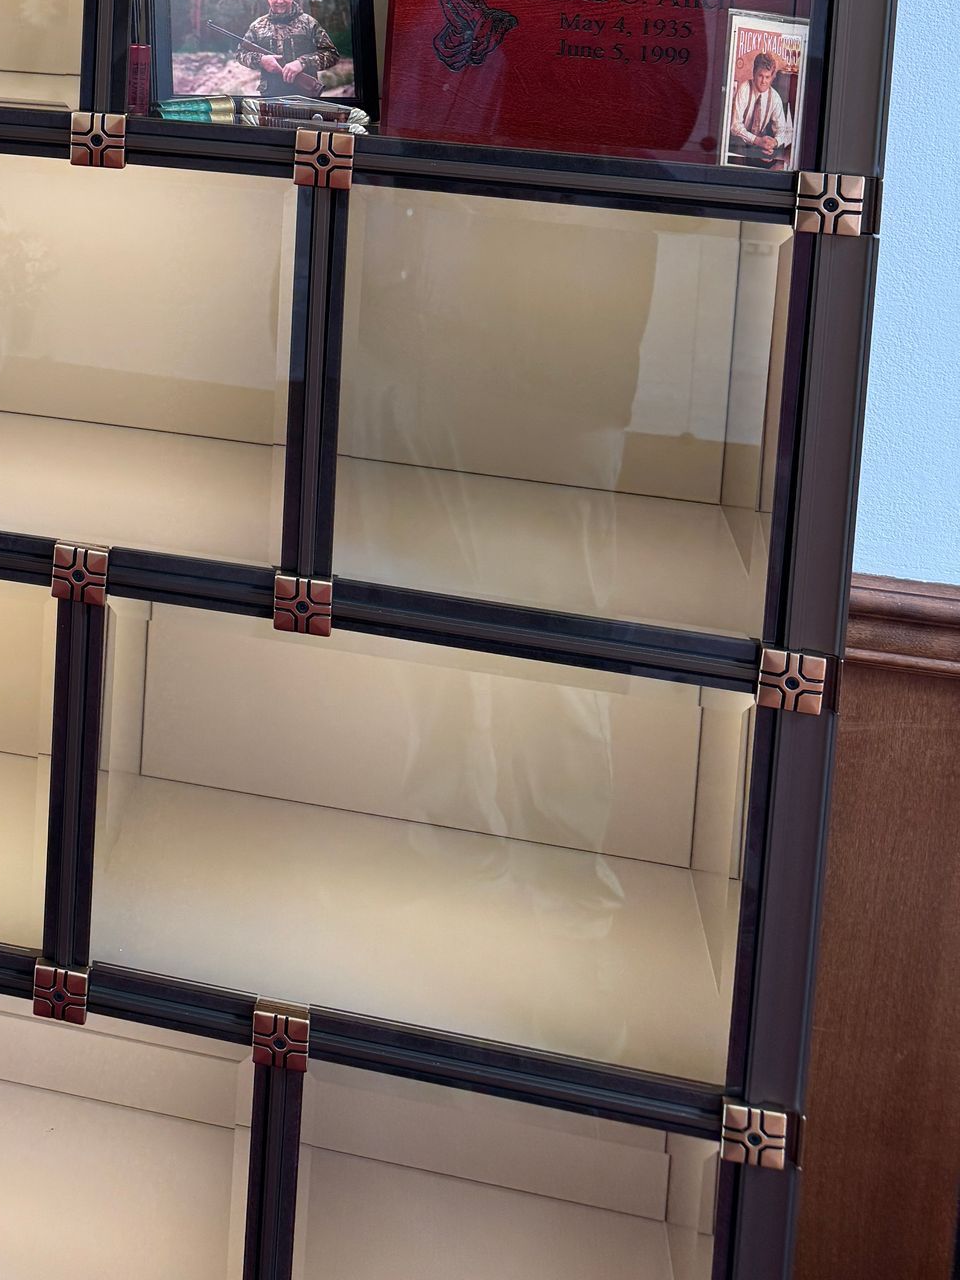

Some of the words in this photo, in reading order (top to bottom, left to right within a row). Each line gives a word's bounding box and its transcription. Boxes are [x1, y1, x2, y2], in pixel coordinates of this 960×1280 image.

[559, 12, 606, 37] May
[612, 16, 632, 38] 4,
[643, 18, 693, 39] 1935
[556, 38, 605, 60] June
[609, 42, 630, 64] 5,
[641, 45, 691, 64] 1999
[738, 30, 762, 58] RICKY
